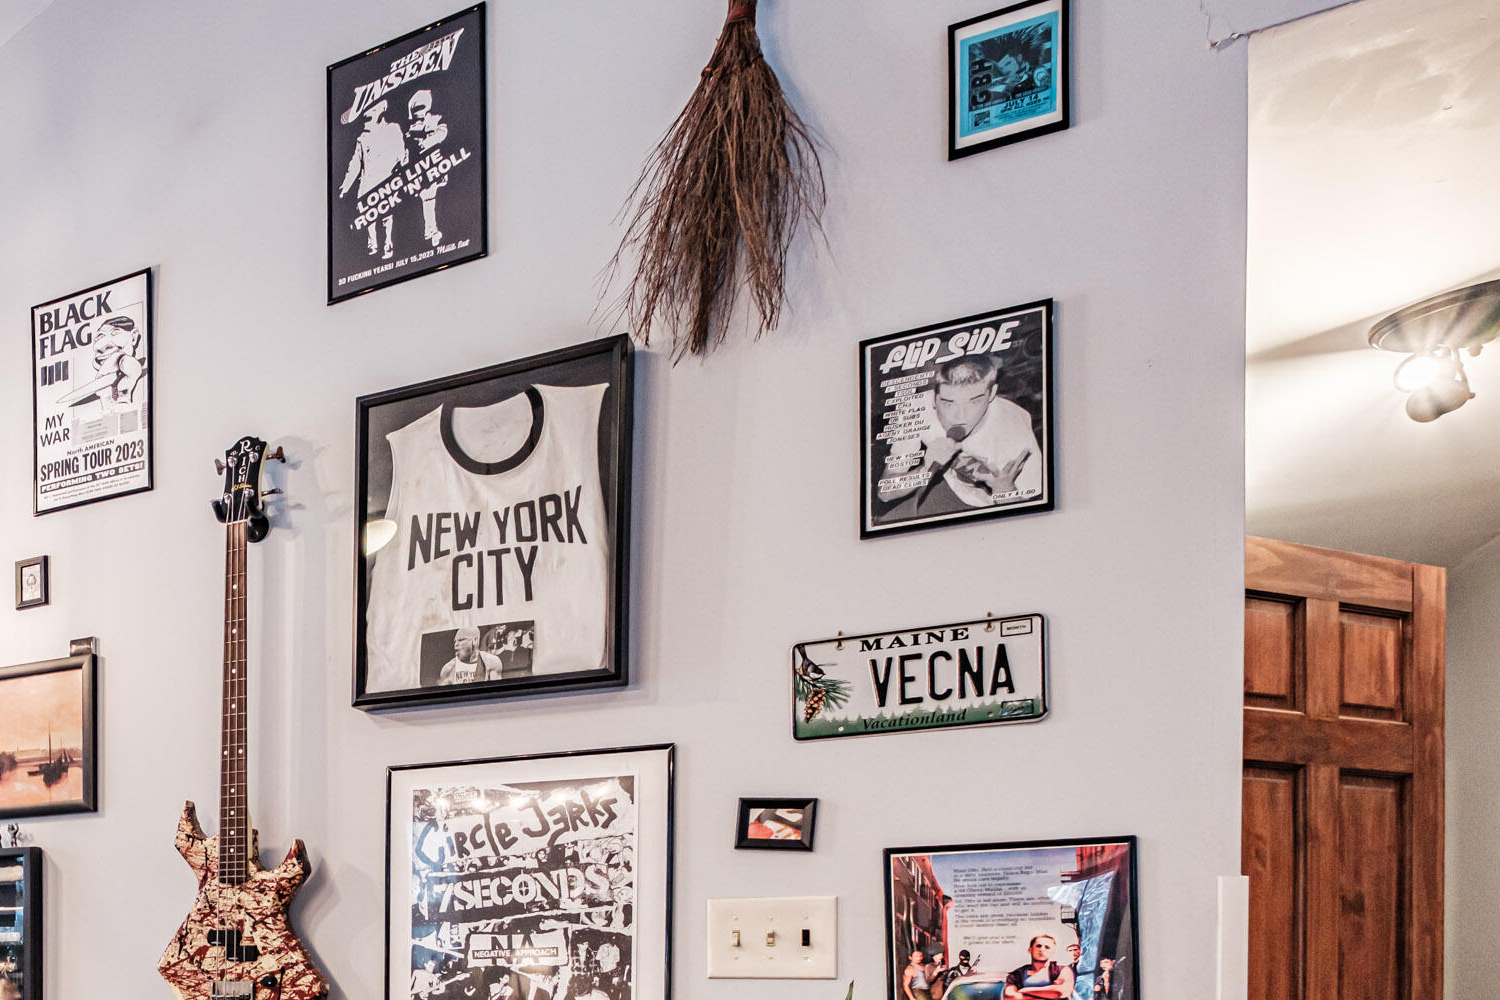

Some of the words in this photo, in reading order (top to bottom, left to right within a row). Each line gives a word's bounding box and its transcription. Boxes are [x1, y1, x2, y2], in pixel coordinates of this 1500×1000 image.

[341, 28, 464, 124] UNSEEN
[1003, 98, 1025, 108] JULY
[354, 193, 402, 231] ROCK
[429, 148, 471, 184] ROLL
[357, 176, 404, 213] LONG
[405, 149, 443, 180] LIVE
[347, 270, 372, 283] FUCKING
[395, 258, 408, 268] JULY
[39, 290, 113, 336] BLACK
[39, 322, 92, 360] FLAG
[45, 413, 65, 431] MY
[40, 427, 70, 448] WAR
[84, 440, 114, 452] AMERICAN
[40, 456, 79, 482] SPRING
[82, 448, 112, 471] TOUR
[115, 439, 144, 462] 2023
[890, 459, 919, 468] BOSTON
[41, 475, 92, 492] PERFORMING
[95, 469, 115, 479] TWO
[408, 511, 481, 571] NEW
[493, 485, 588, 545] YORK
[451, 545, 538, 611] CITY
[860, 628, 969, 652] MAINE
[869, 644, 1015, 708] VECNA
[863, 709, 967, 730] Vacationland
[474, 950, 511, 958] NEGATIVE
